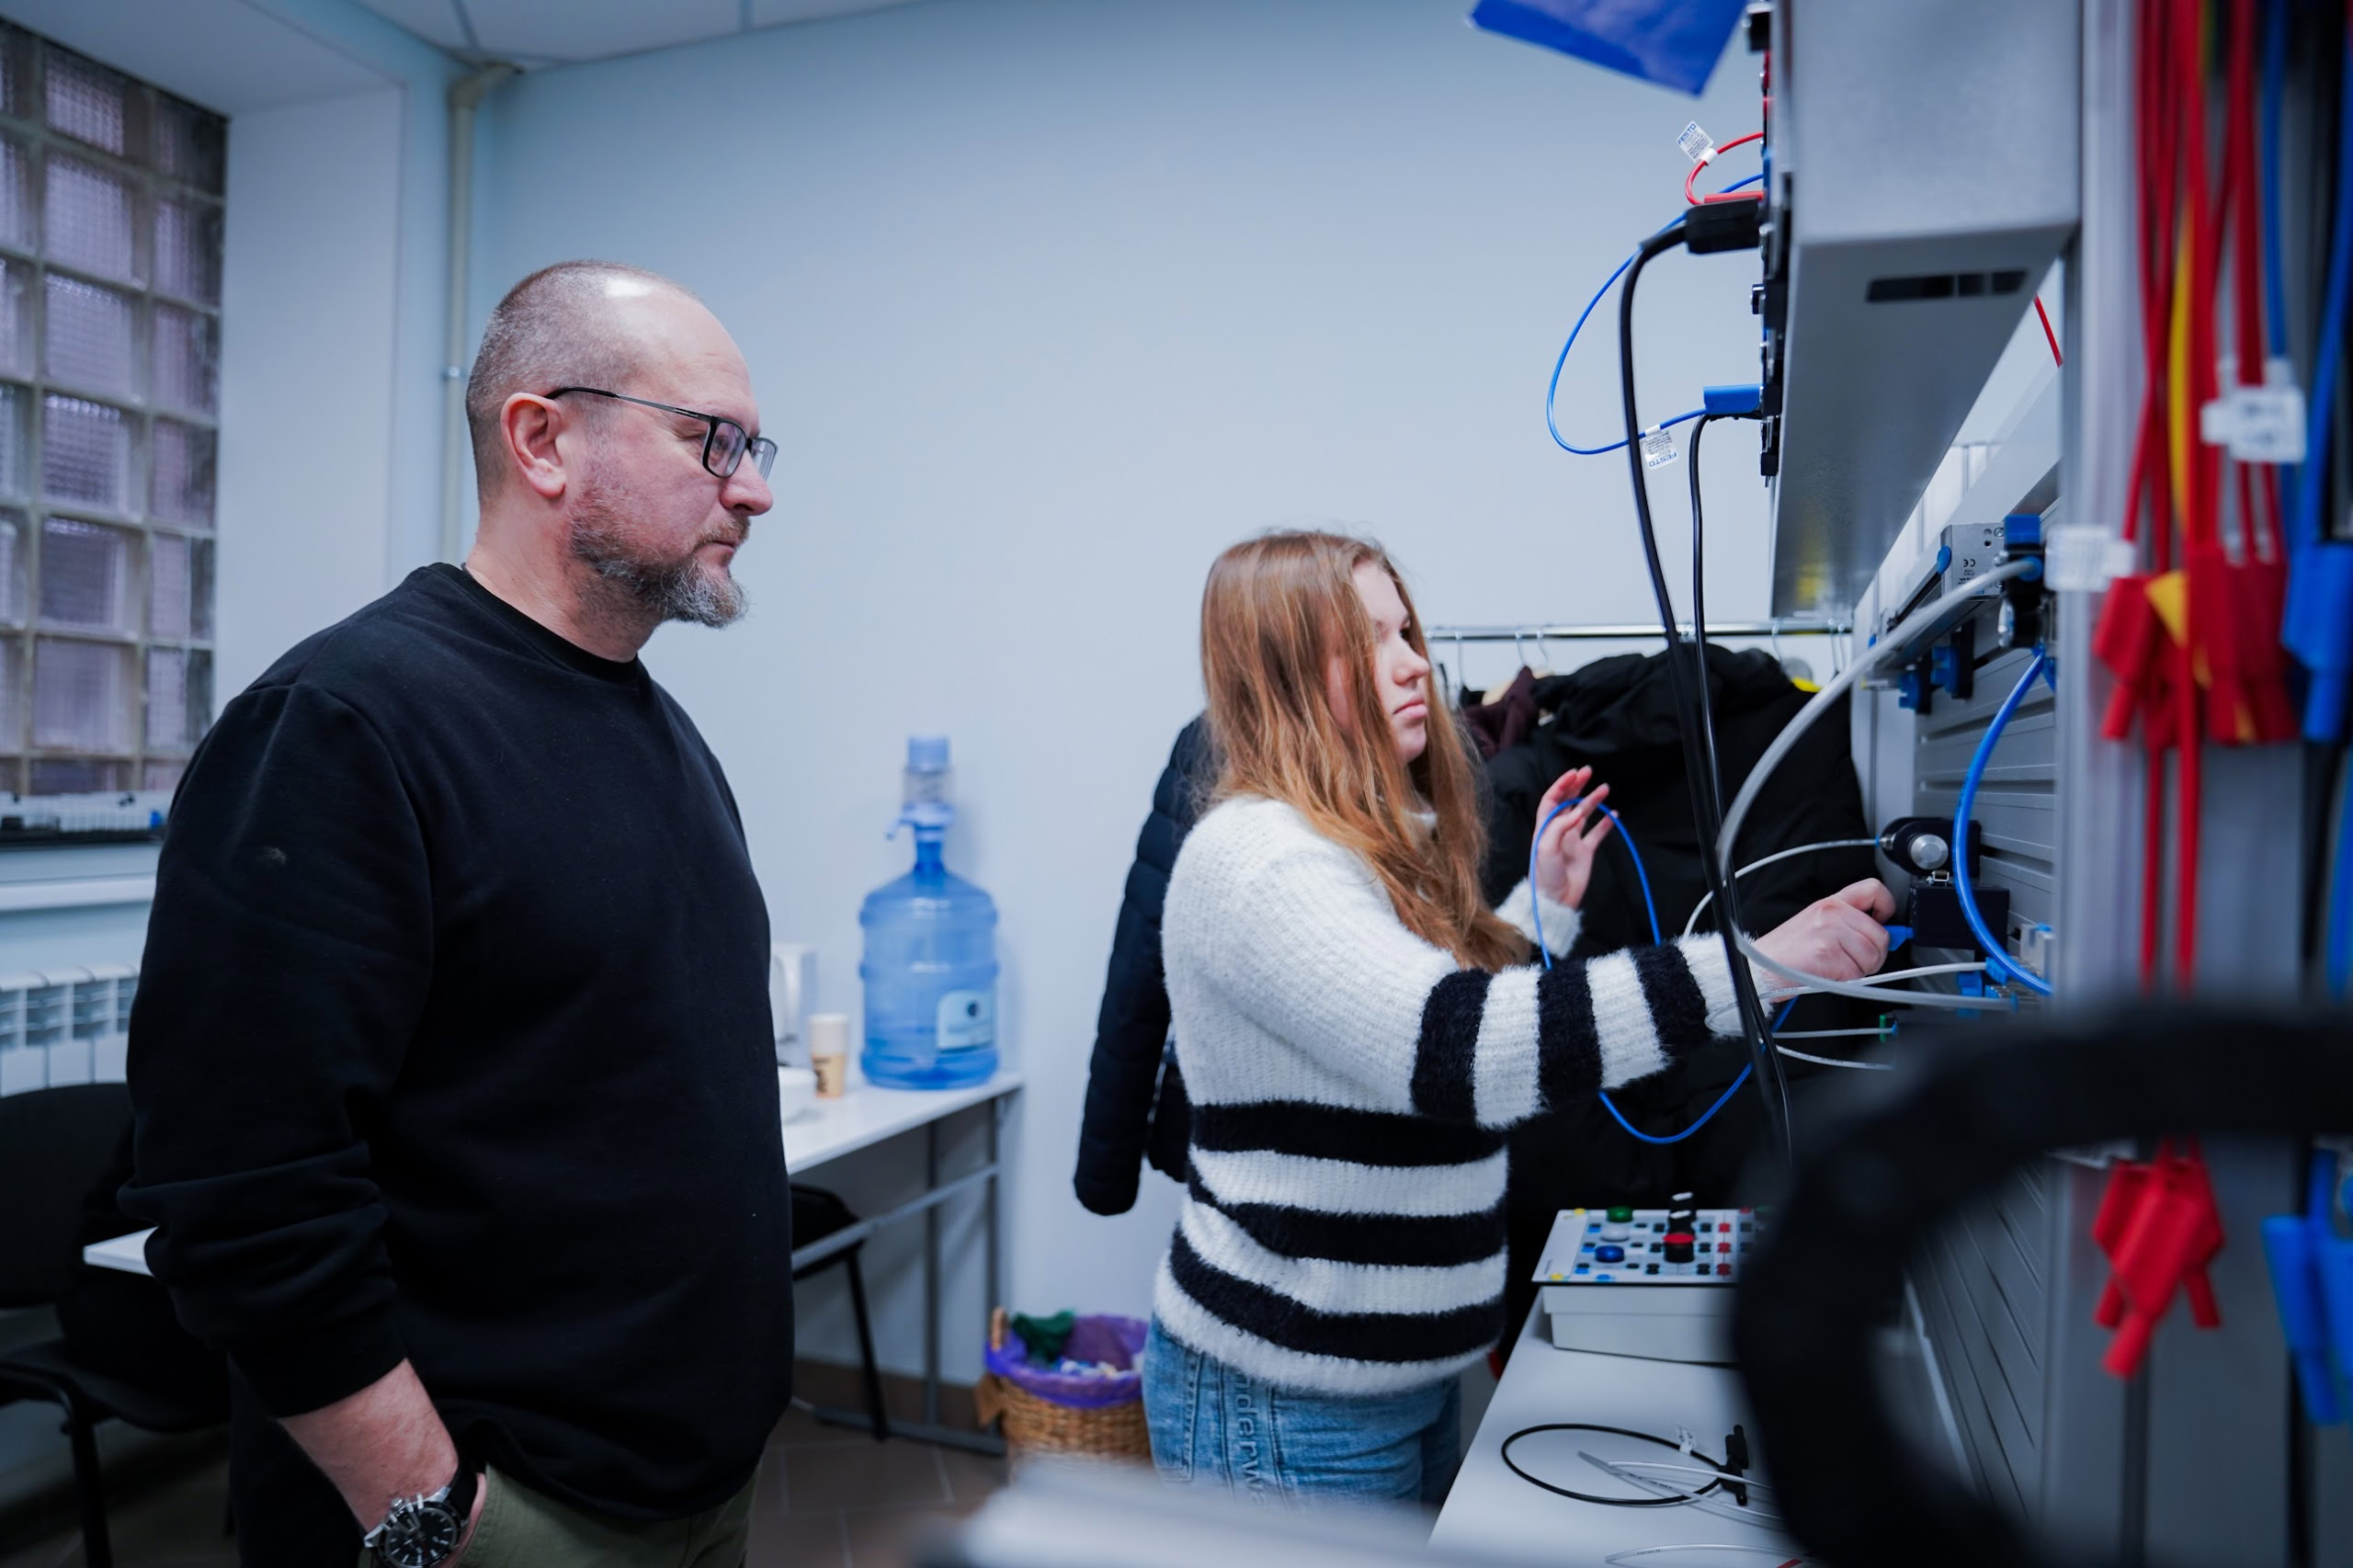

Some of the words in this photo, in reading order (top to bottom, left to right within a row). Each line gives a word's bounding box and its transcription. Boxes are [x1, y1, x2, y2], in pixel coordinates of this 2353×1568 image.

[1677, 123, 1696, 145] FESTO
[1648, 451, 1677, 467] FESTO
[1962, 558, 1976, 567] CE
